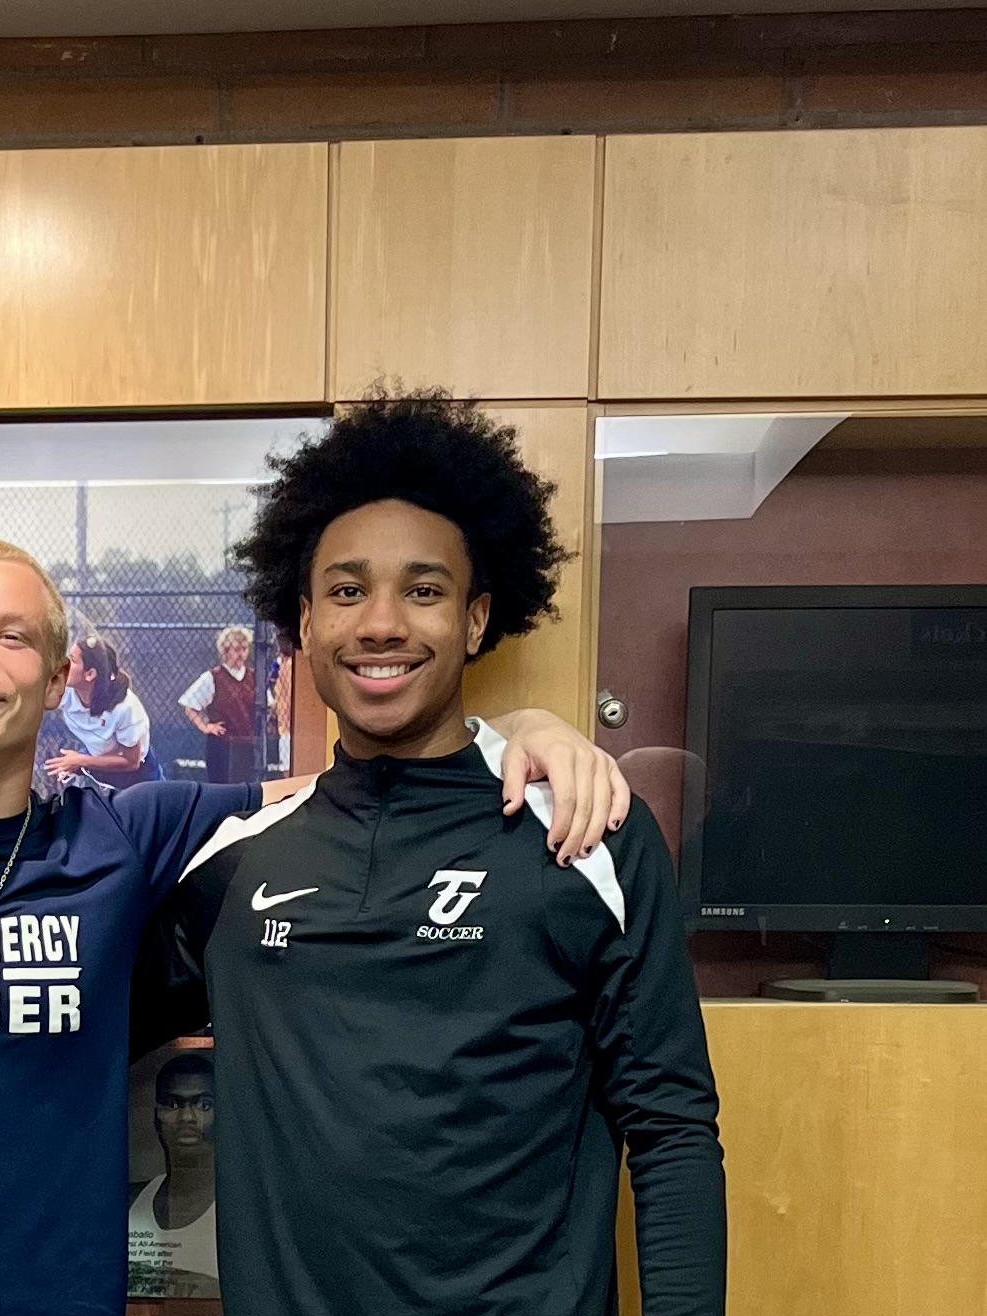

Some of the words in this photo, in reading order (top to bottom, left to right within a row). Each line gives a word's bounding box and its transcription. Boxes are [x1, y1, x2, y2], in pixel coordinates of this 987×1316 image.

[701, 907, 745, 916] SAMSUNG
[260, 919, 292, 948] 112
[416, 925, 484, 941] SOCCER
